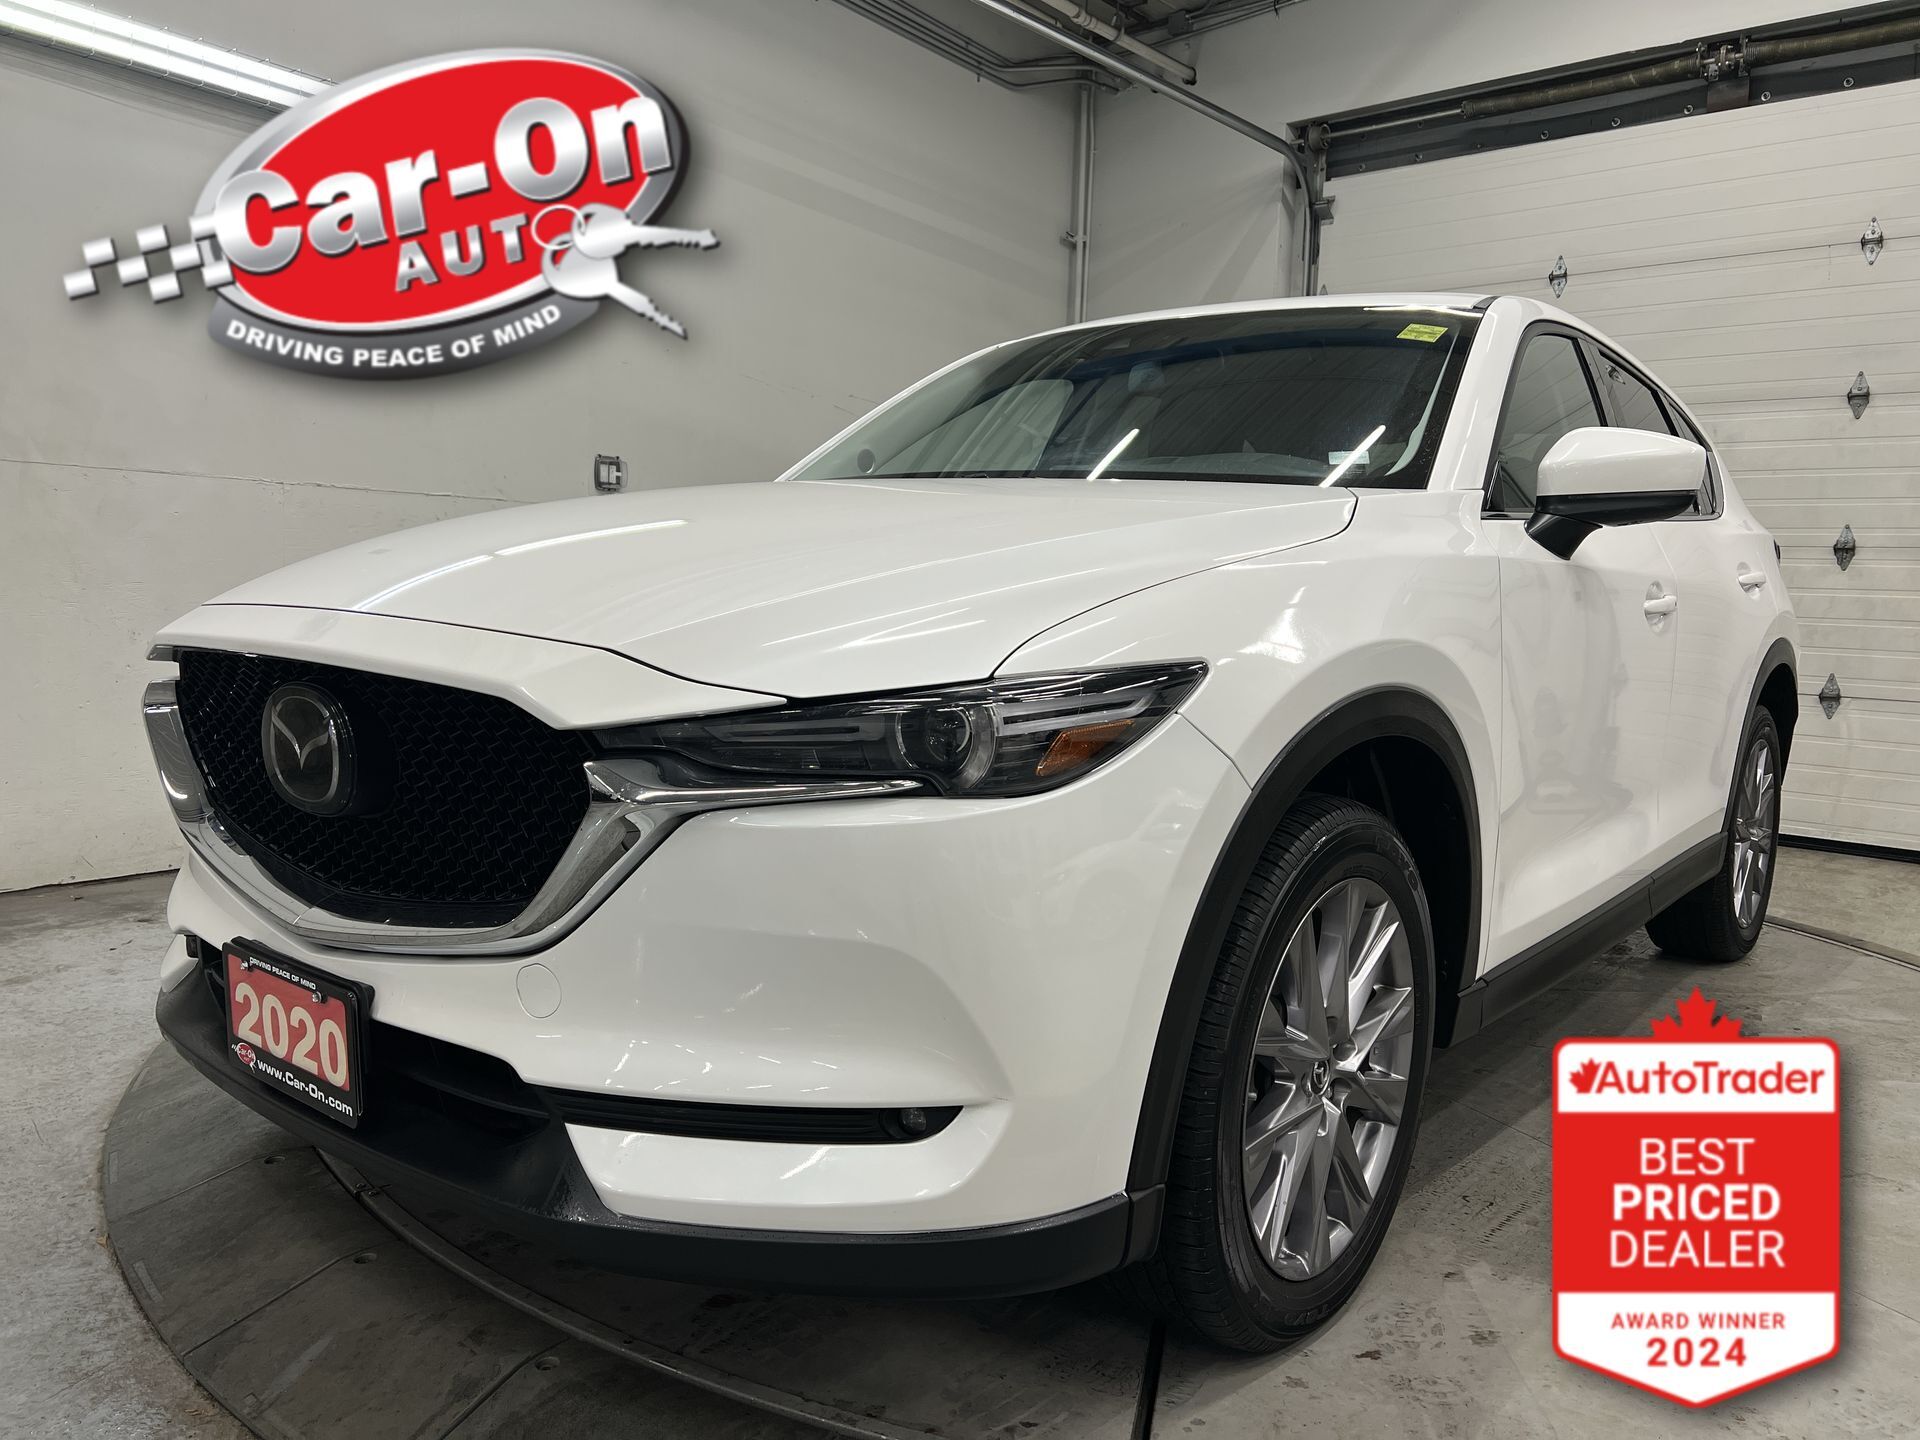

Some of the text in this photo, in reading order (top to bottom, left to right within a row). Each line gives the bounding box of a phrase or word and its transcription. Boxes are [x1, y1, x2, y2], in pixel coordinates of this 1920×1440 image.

[249, 956, 316, 990] DRIVING PEACE OF MIND
[235, 982, 347, 1087] 2020
[257, 1060, 353, 1117] www.Car-On.com
